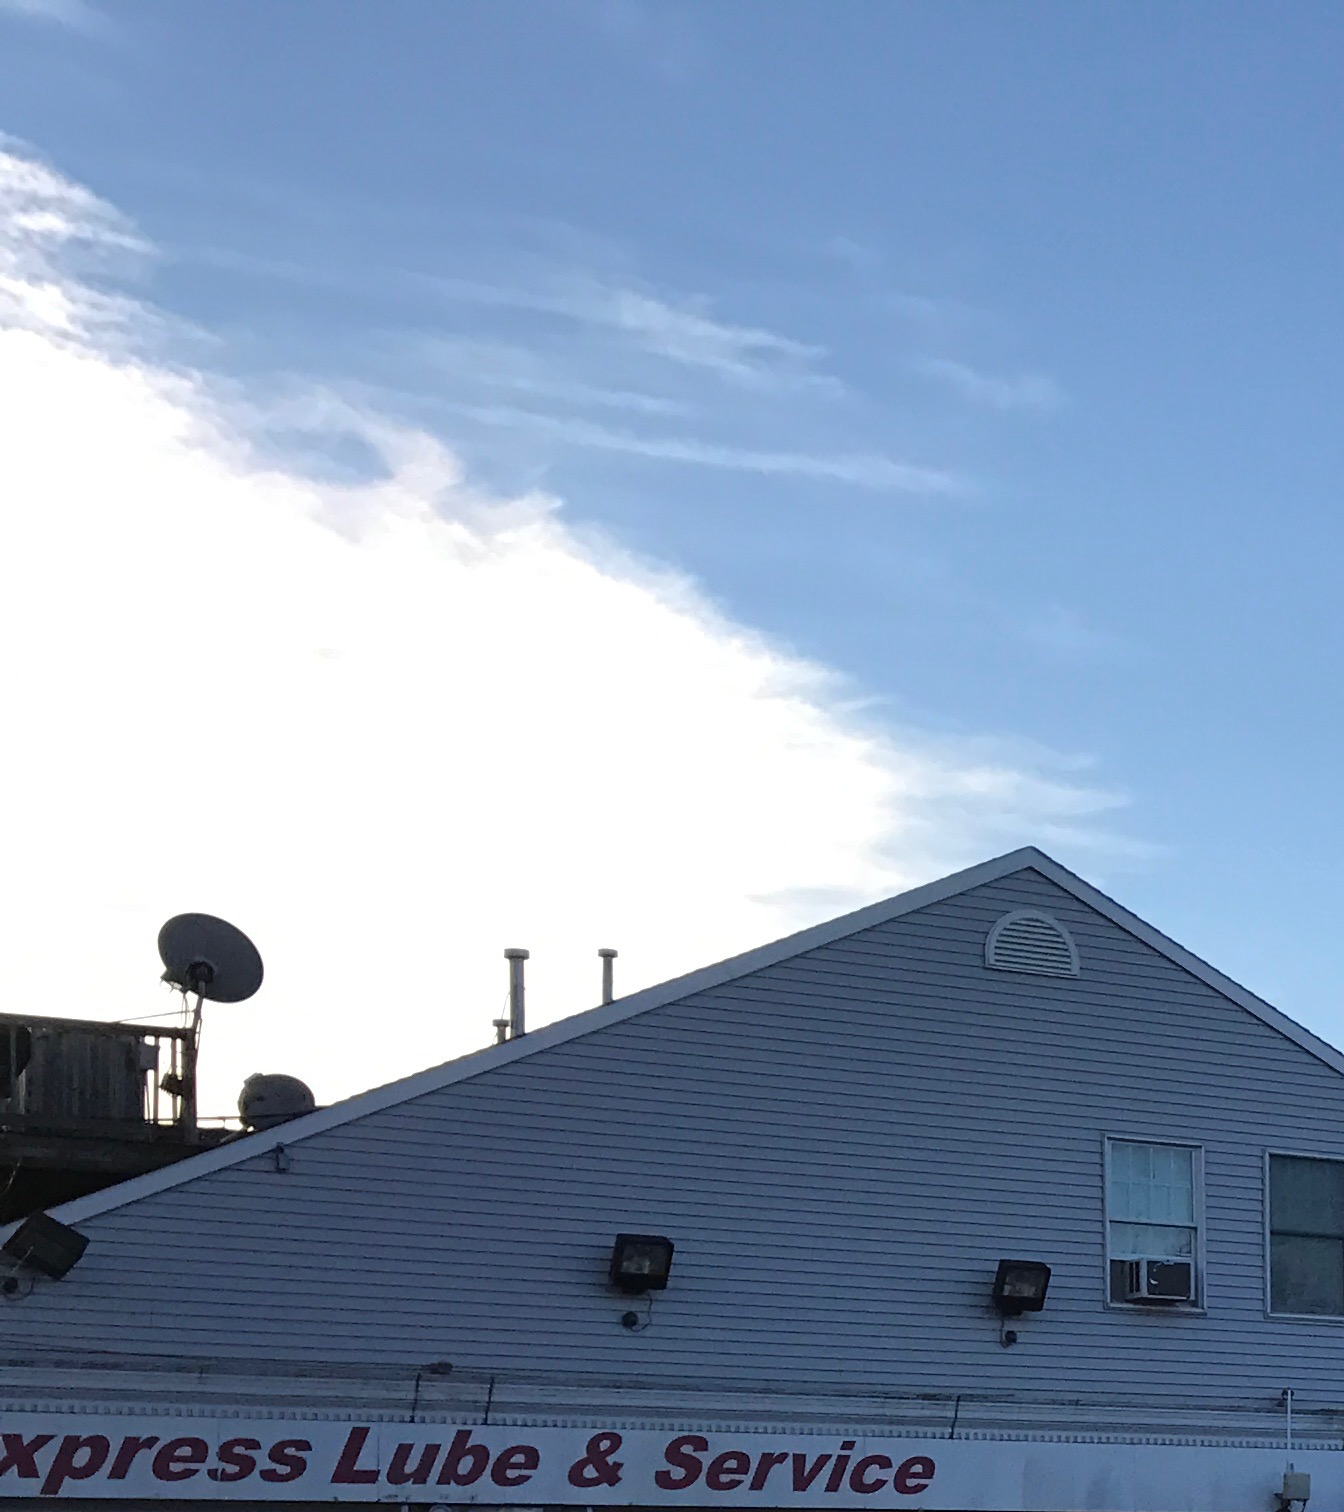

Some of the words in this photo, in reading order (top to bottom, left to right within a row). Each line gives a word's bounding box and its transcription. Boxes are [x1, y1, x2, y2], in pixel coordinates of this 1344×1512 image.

[330, 1426, 540, 1486] Lube
[567, 1432, 624, 1488] &
[654, 1435, 936, 1495] Service
